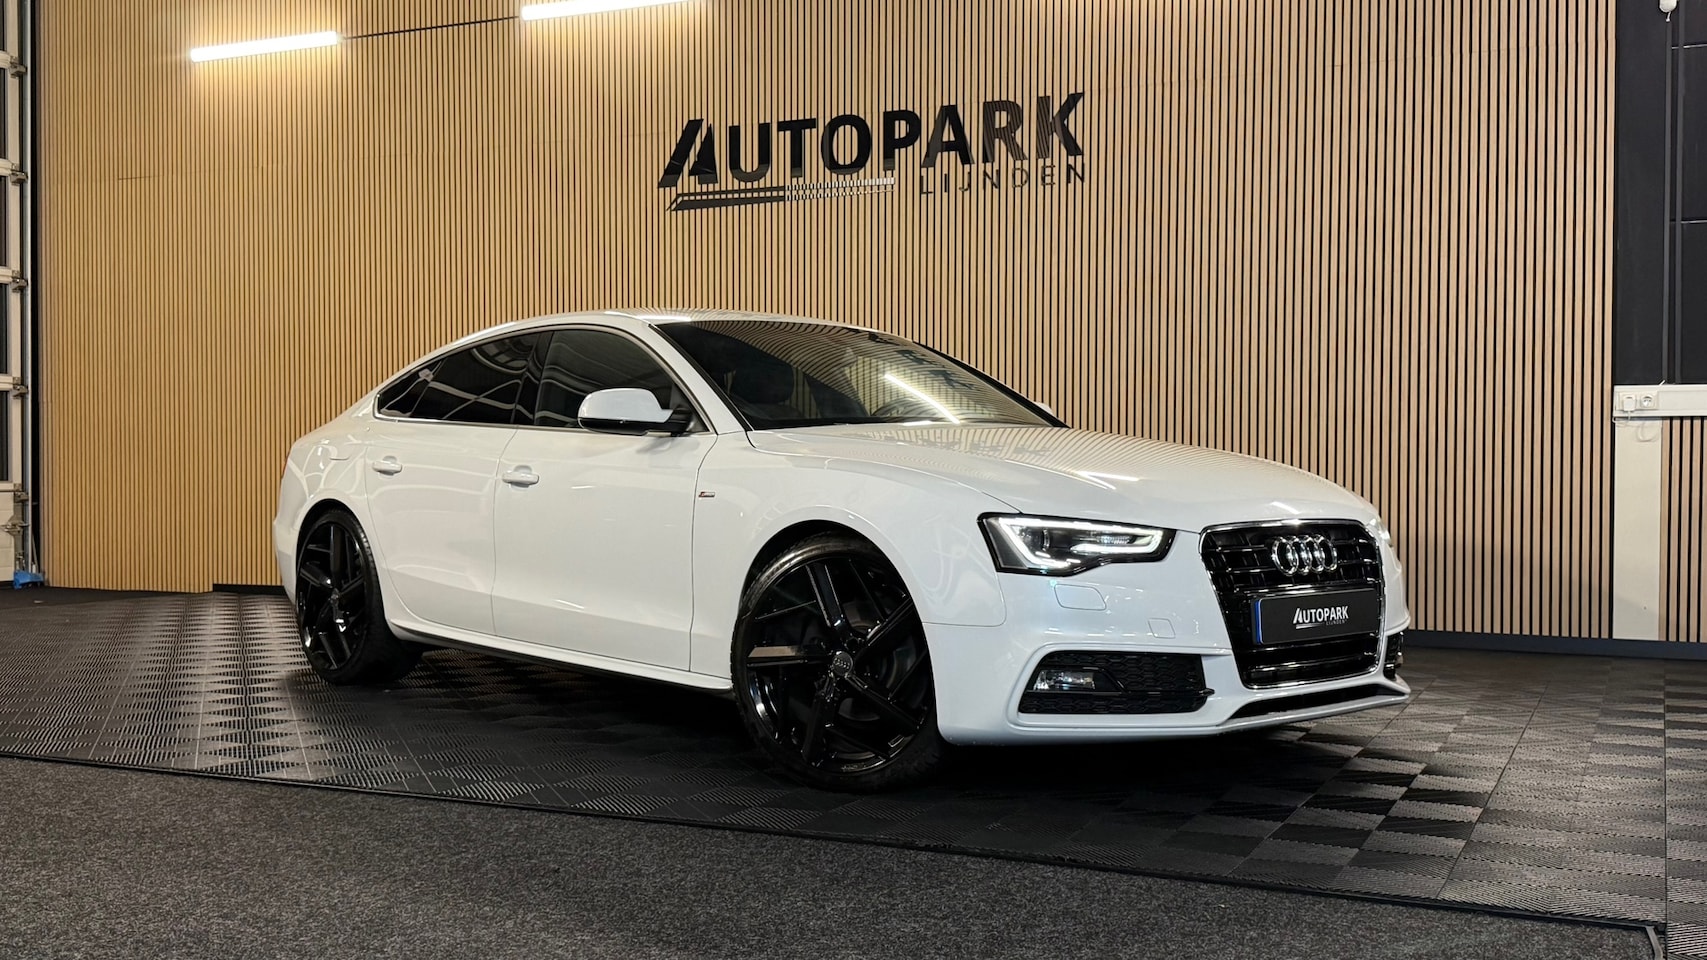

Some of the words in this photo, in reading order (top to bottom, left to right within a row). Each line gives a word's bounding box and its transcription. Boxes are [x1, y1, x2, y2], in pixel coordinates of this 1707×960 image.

[657, 92, 1085, 189] AUTOPARK
[920, 162, 1085, 195] LIJNDEN
[1293, 606, 1349, 624] AUTOPARK
